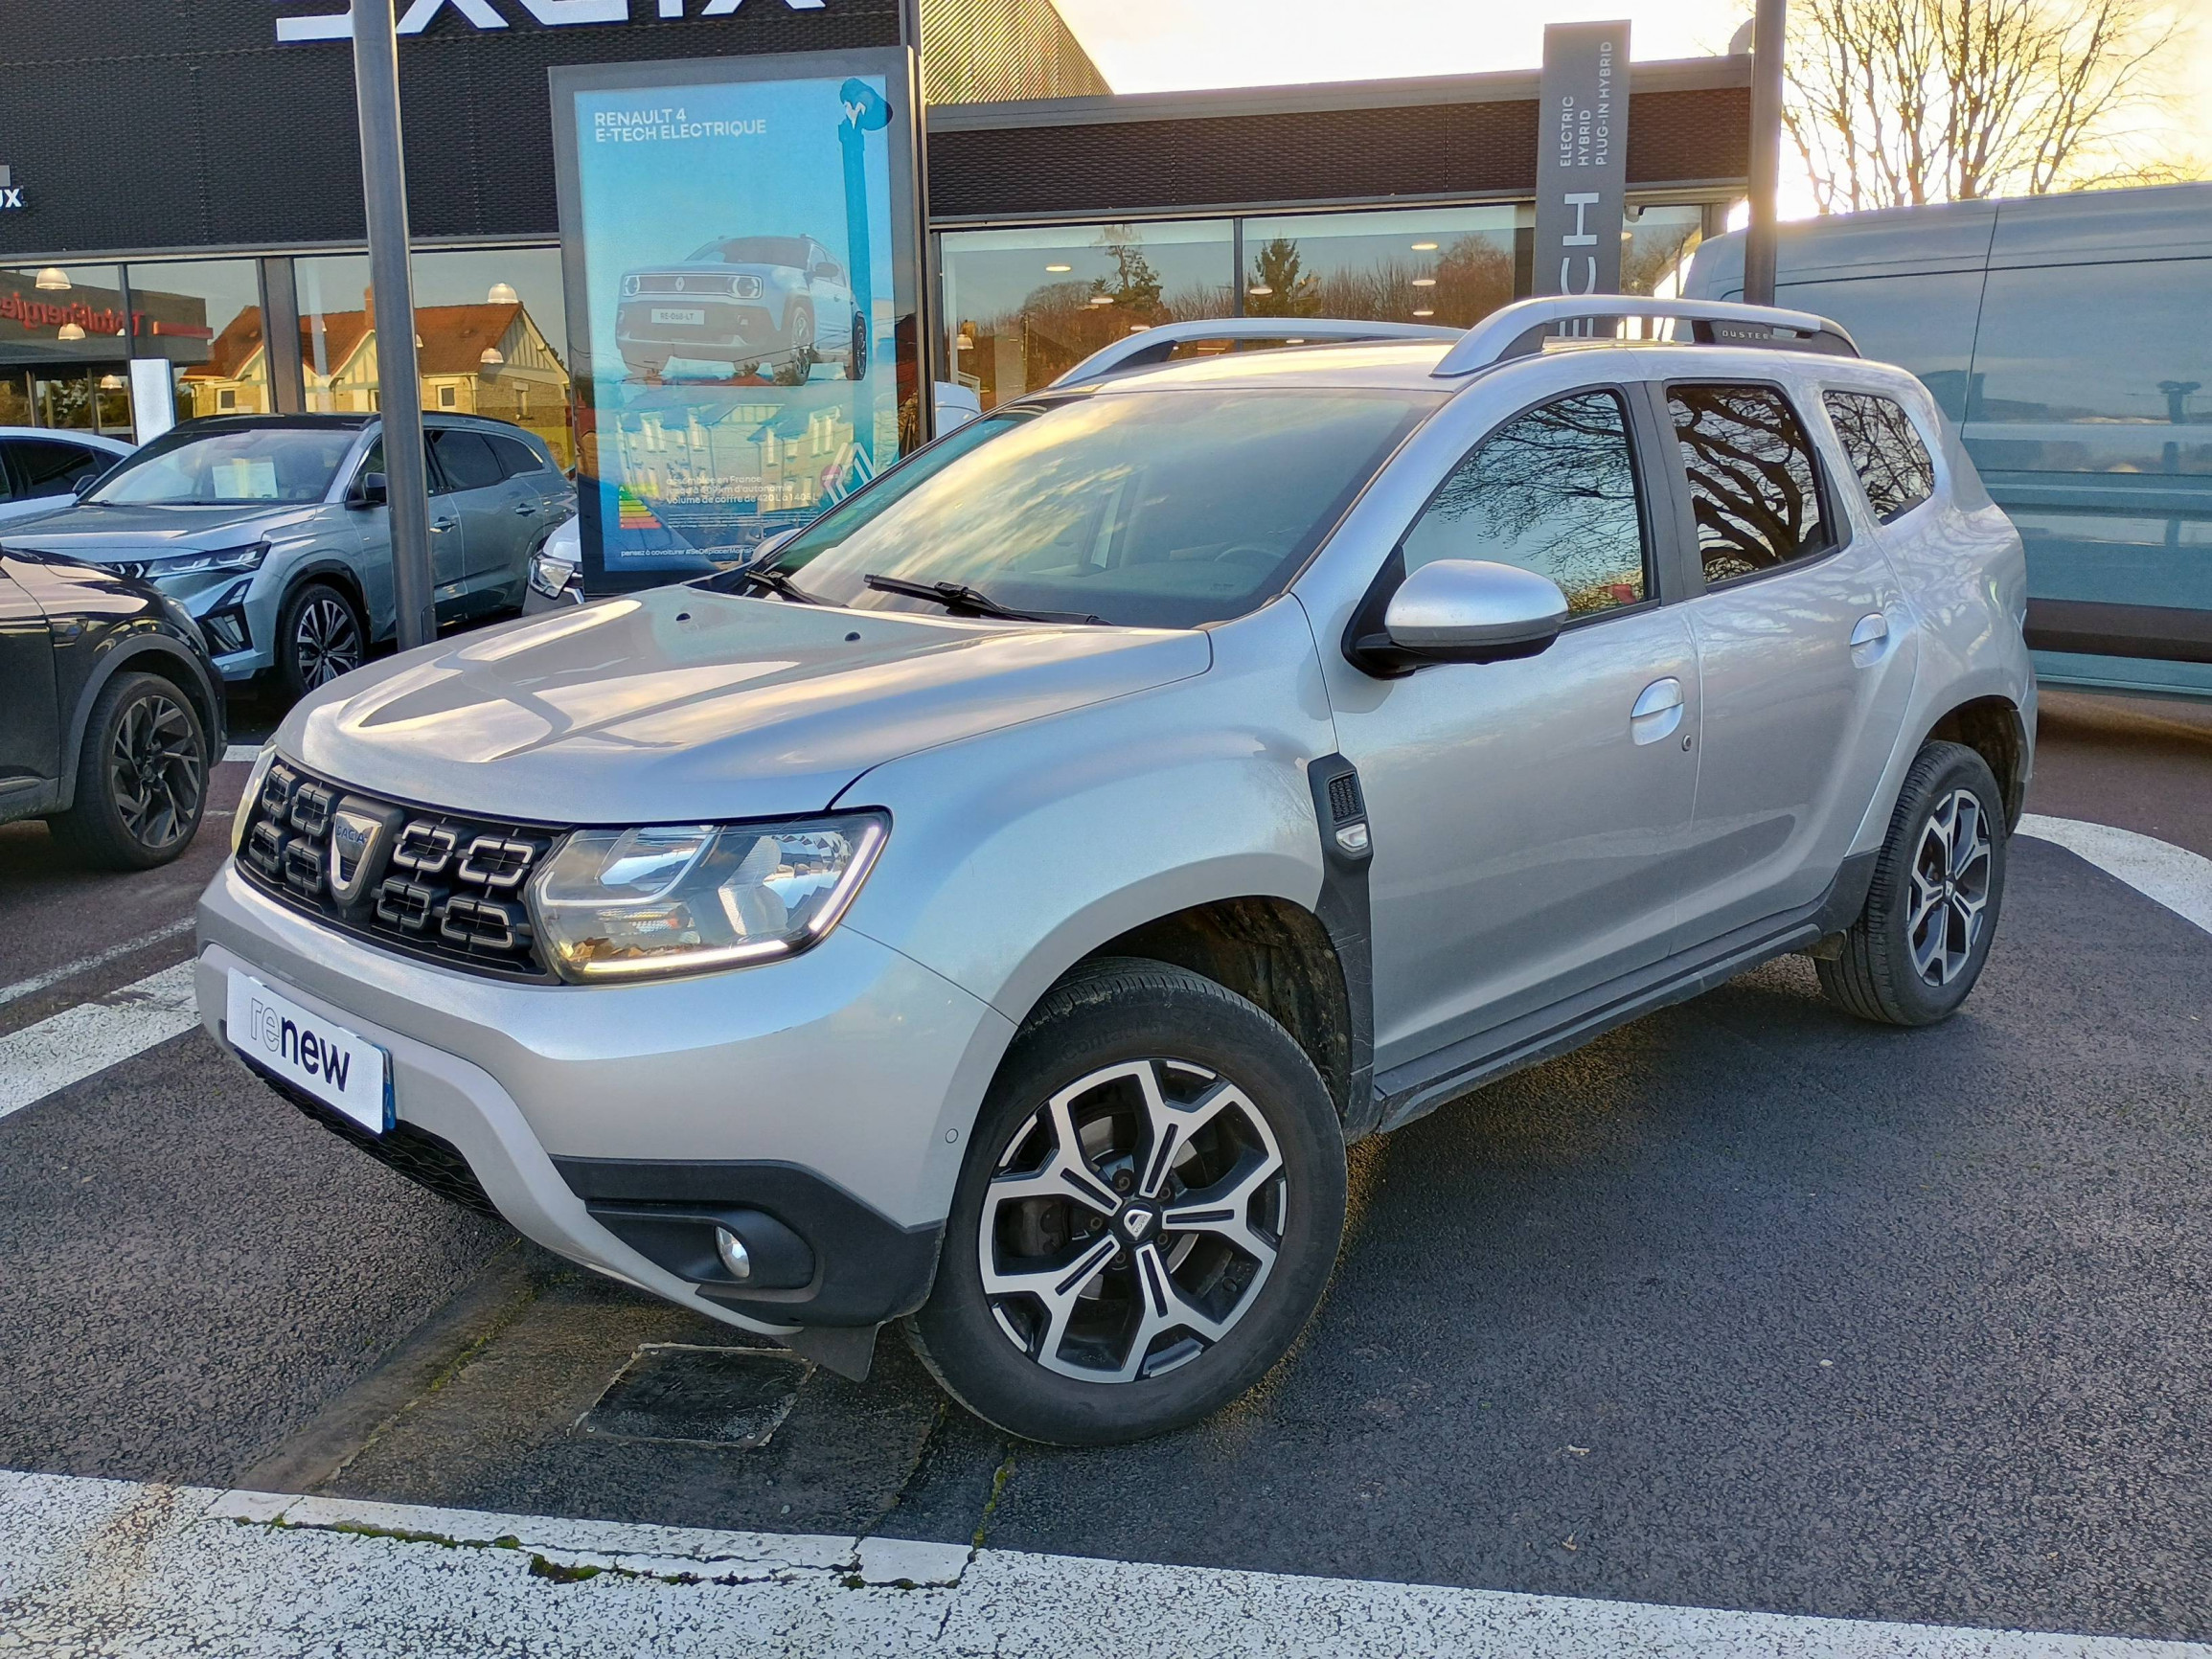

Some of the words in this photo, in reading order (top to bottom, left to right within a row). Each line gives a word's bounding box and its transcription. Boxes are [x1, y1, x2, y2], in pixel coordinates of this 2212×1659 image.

[1599, 41, 1612, 98] HYBRID
[594, 108, 673, 126] RENAULT
[675, 107, 687, 122] 4
[595, 126, 657, 142] E-TECH
[661, 119, 766, 139] ELECTRIQUE
[1560, 96, 1574, 167] ELECTRIC
[1595, 102, 1609, 165] PLUG-IN
[1577, 109, 1591, 166] HYBRID
[1722, 330, 1768, 340] DUSTER
[715, 493, 742, 503] coffre
[336, 826, 365, 844] DACIA
[251, 998, 351, 1093] renew
